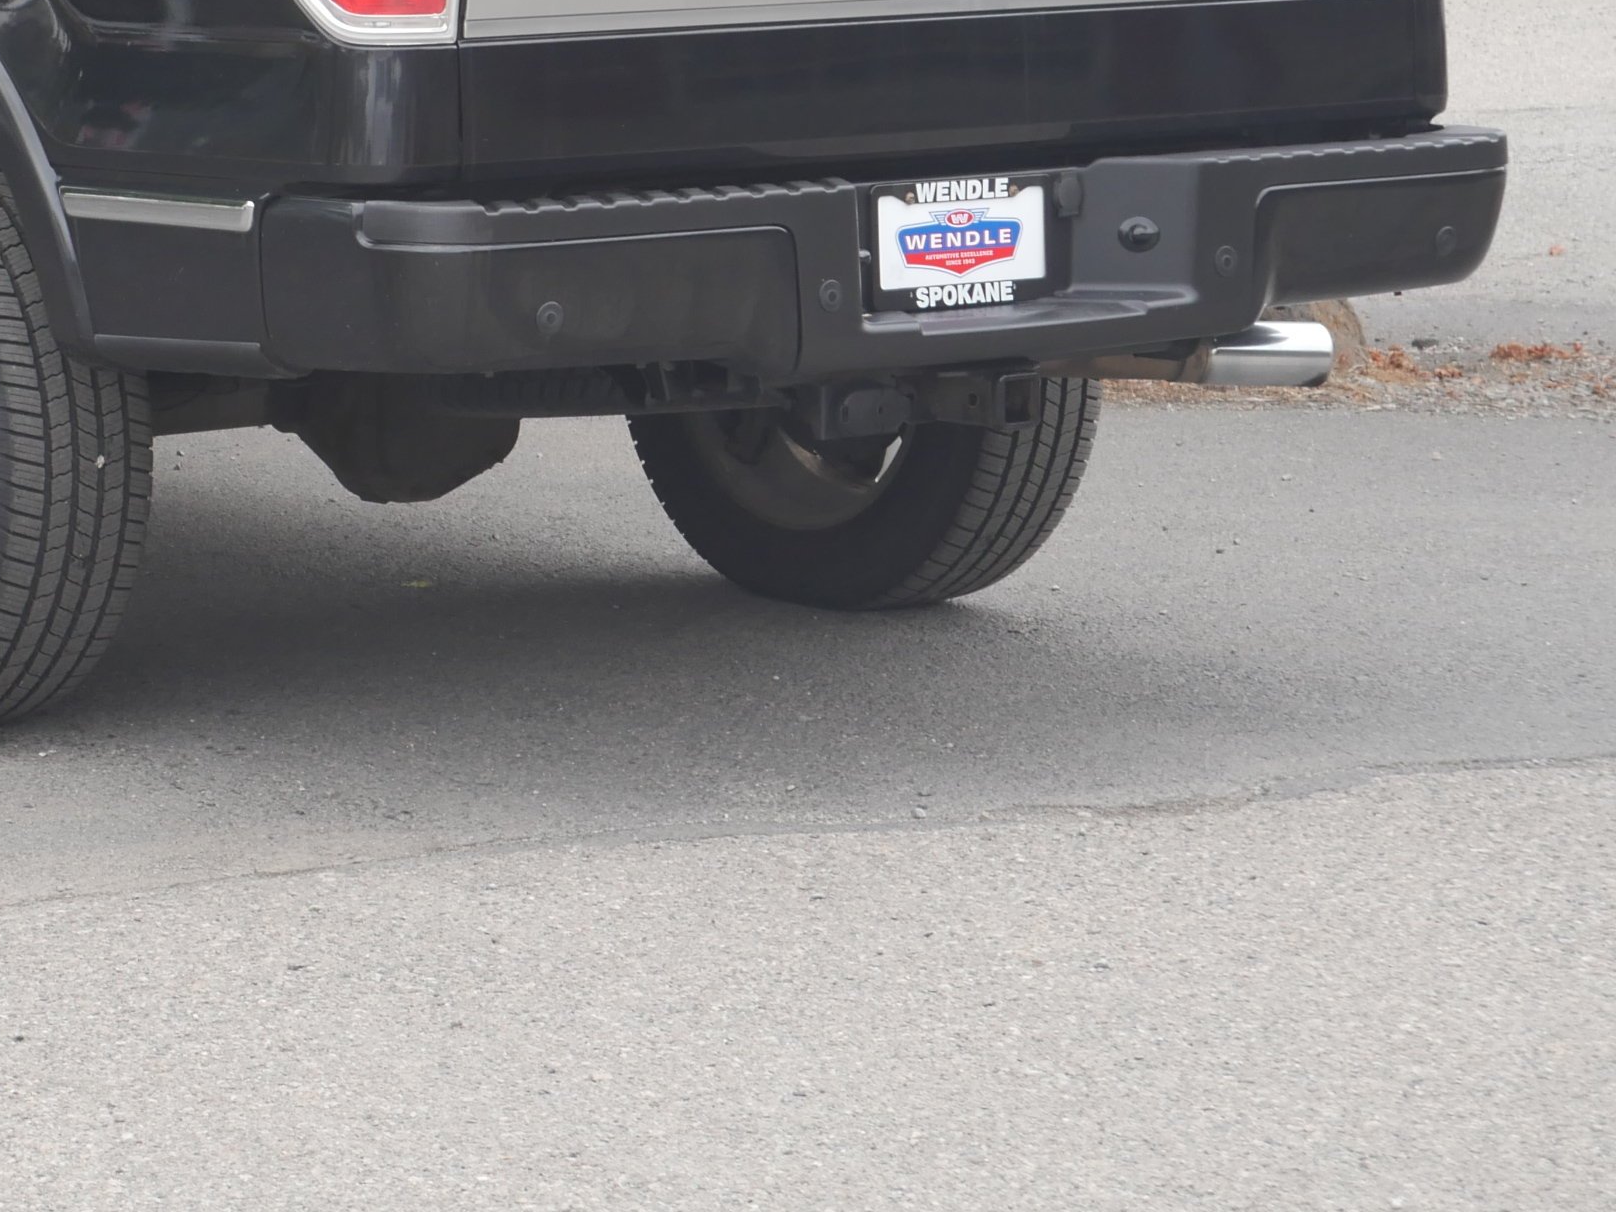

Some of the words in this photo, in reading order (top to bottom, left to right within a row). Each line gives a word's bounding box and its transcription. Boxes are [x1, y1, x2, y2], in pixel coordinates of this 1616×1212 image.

[916, 177, 1009, 203] WENDLE
[905, 228, 1012, 251] WENDLE
[916, 281, 1014, 308] SPOKANE
